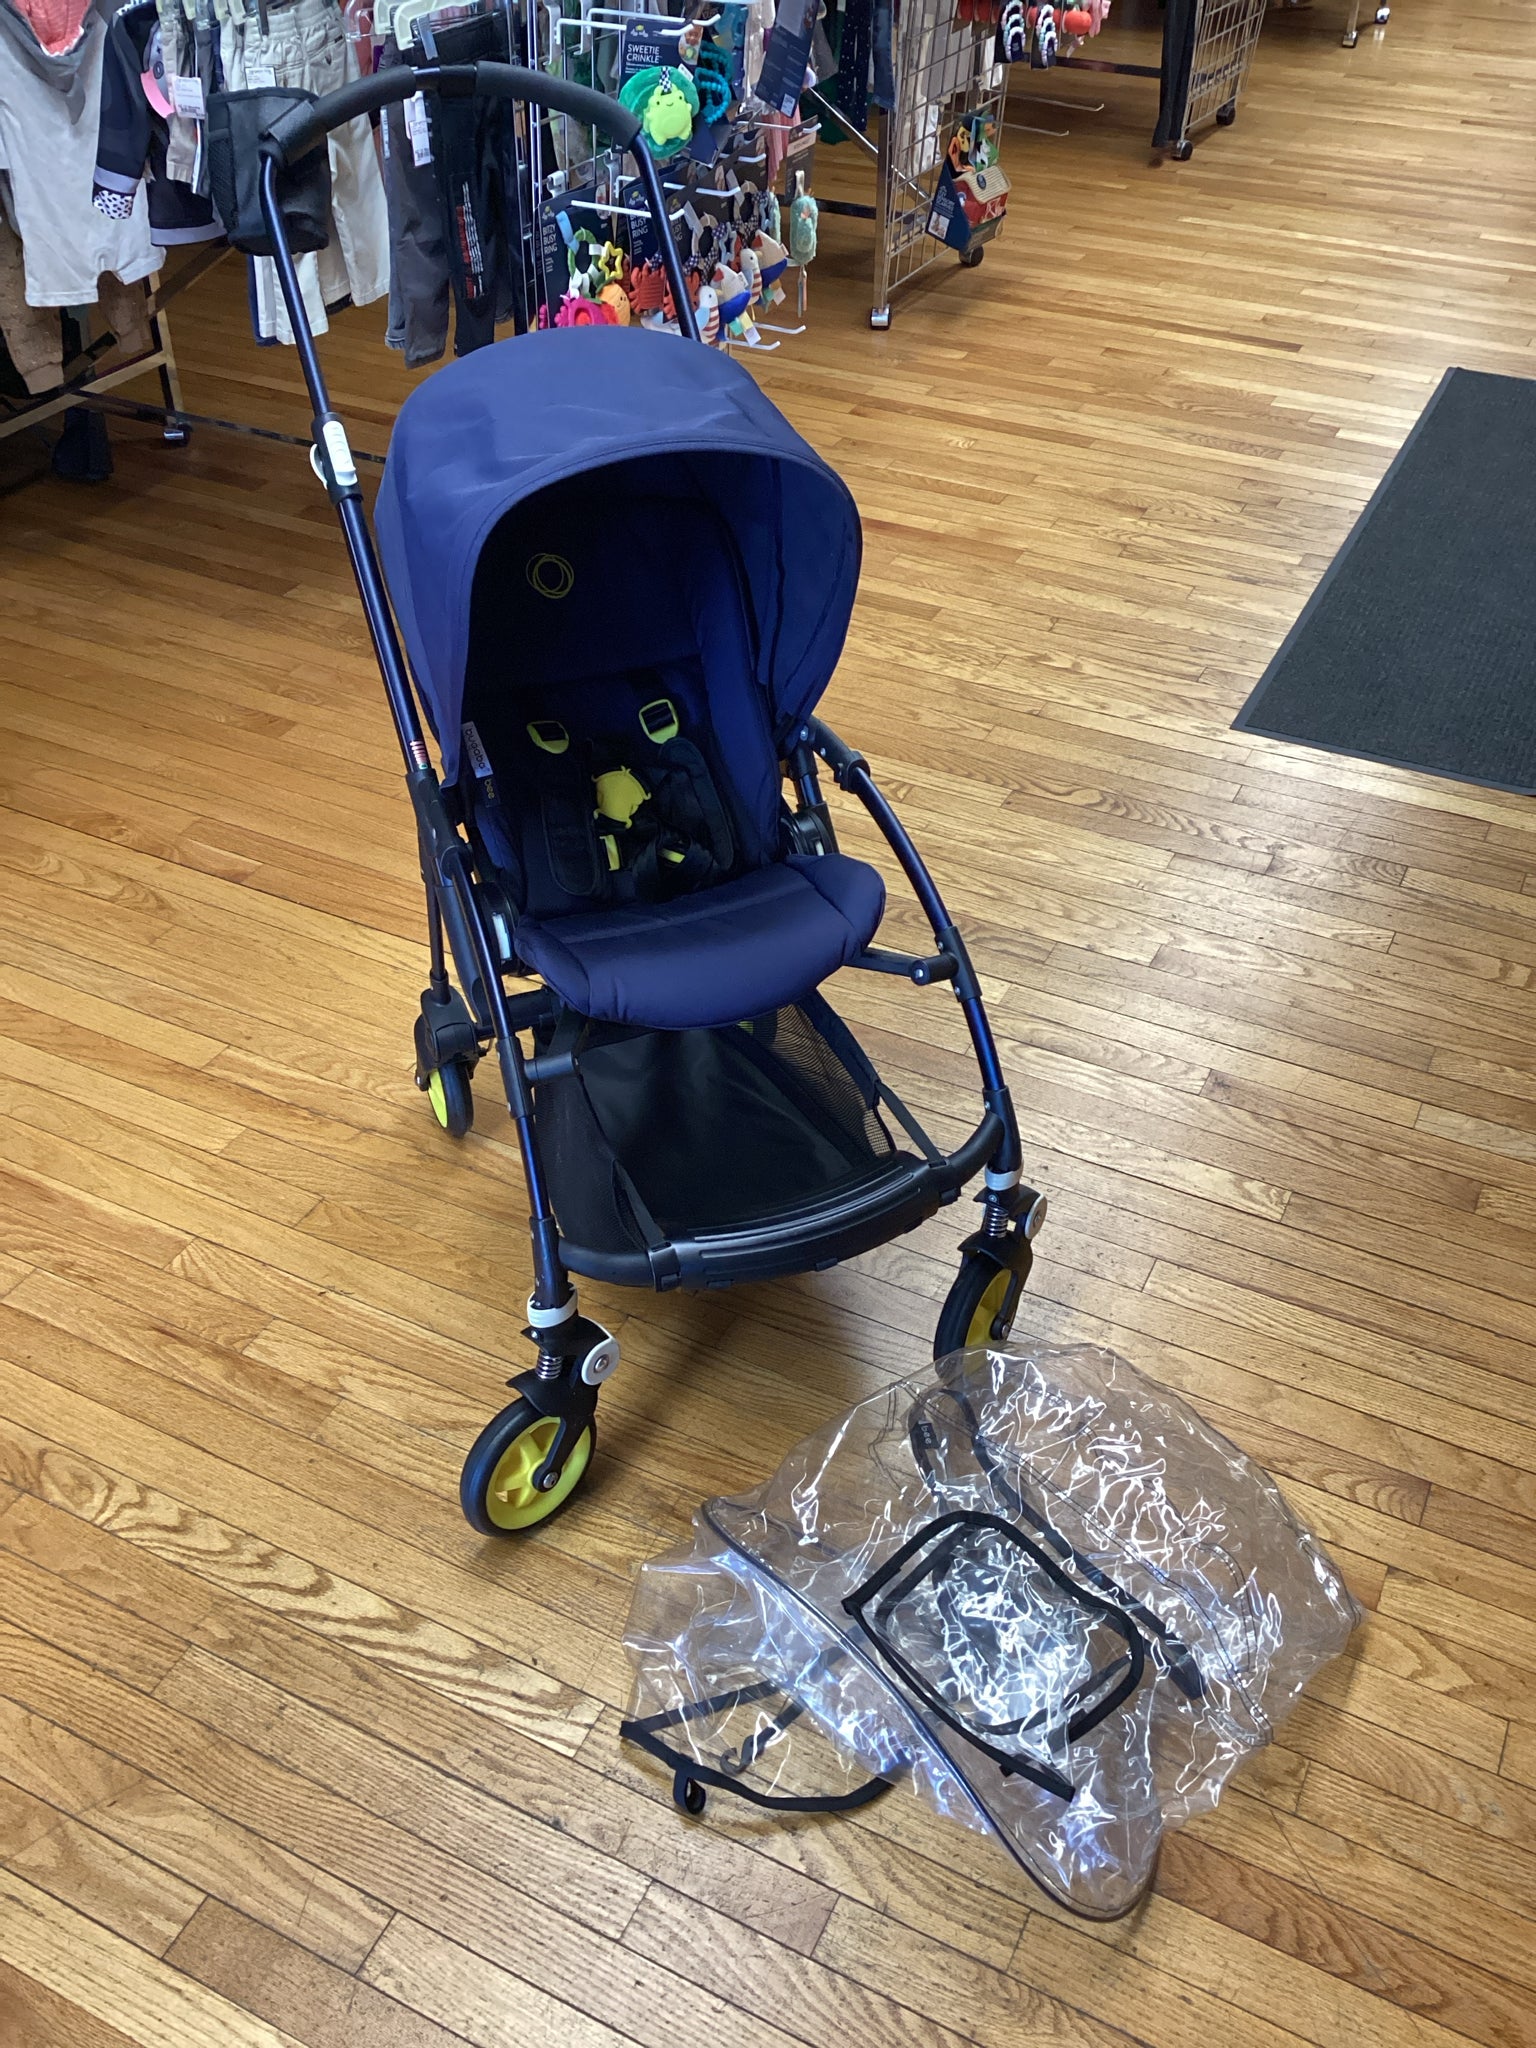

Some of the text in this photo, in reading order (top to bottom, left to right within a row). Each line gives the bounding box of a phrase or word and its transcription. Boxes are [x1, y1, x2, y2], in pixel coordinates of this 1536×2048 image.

[628, 44, 660, 56] SWEETIE
[626, 53, 660, 64] CRINKLE
[630, 217, 647, 230] BUSY
[632, 225, 649, 239] RING
[543, 233, 557, 246] BUSY
[544, 243, 558, 255] RING
[484, 779, 495, 799] bee
[920, 1425, 932, 1445] bee
